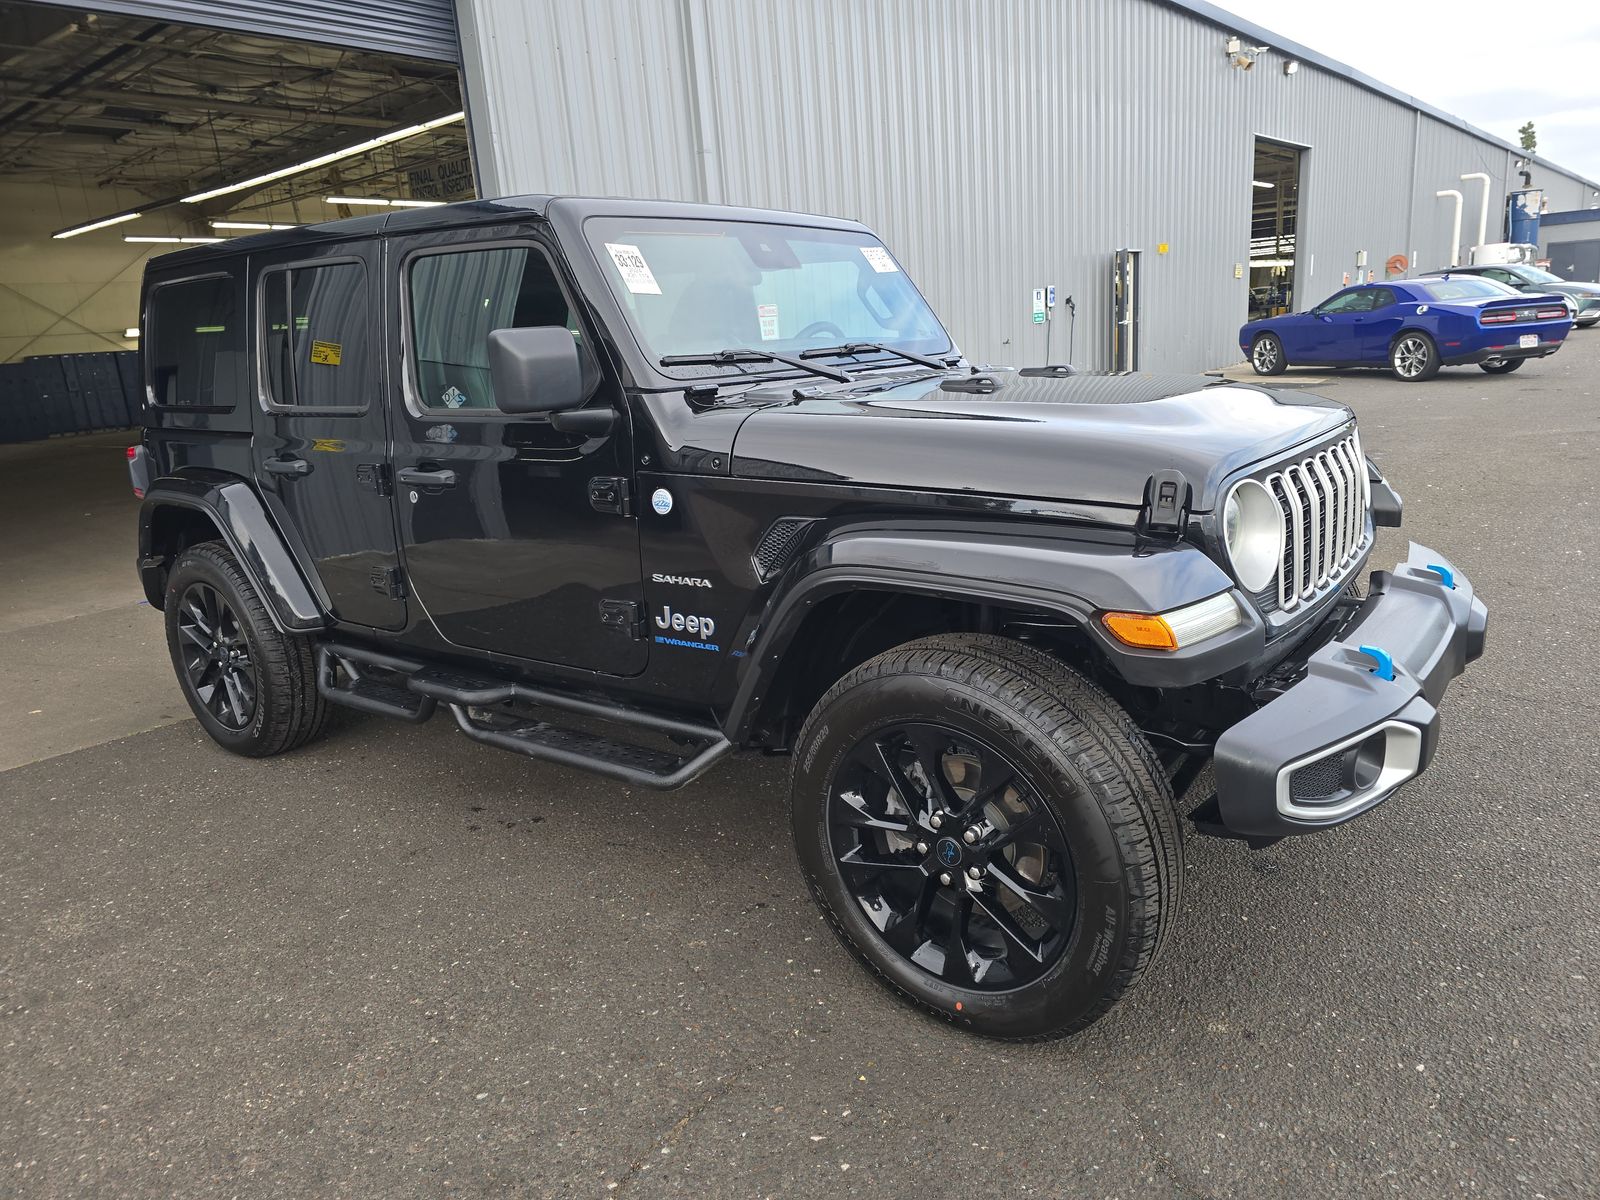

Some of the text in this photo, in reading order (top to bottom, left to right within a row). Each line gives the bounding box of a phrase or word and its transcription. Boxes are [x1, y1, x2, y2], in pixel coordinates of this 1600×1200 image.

[409, 159, 469, 187] FINAL QUALIT
[443, 174, 475, 195] INSPECTIO
[652, 573, 713, 588] SAHARA
[655, 605, 715, 640] Jeep
[663, 637, 720, 652] WRANGLER
